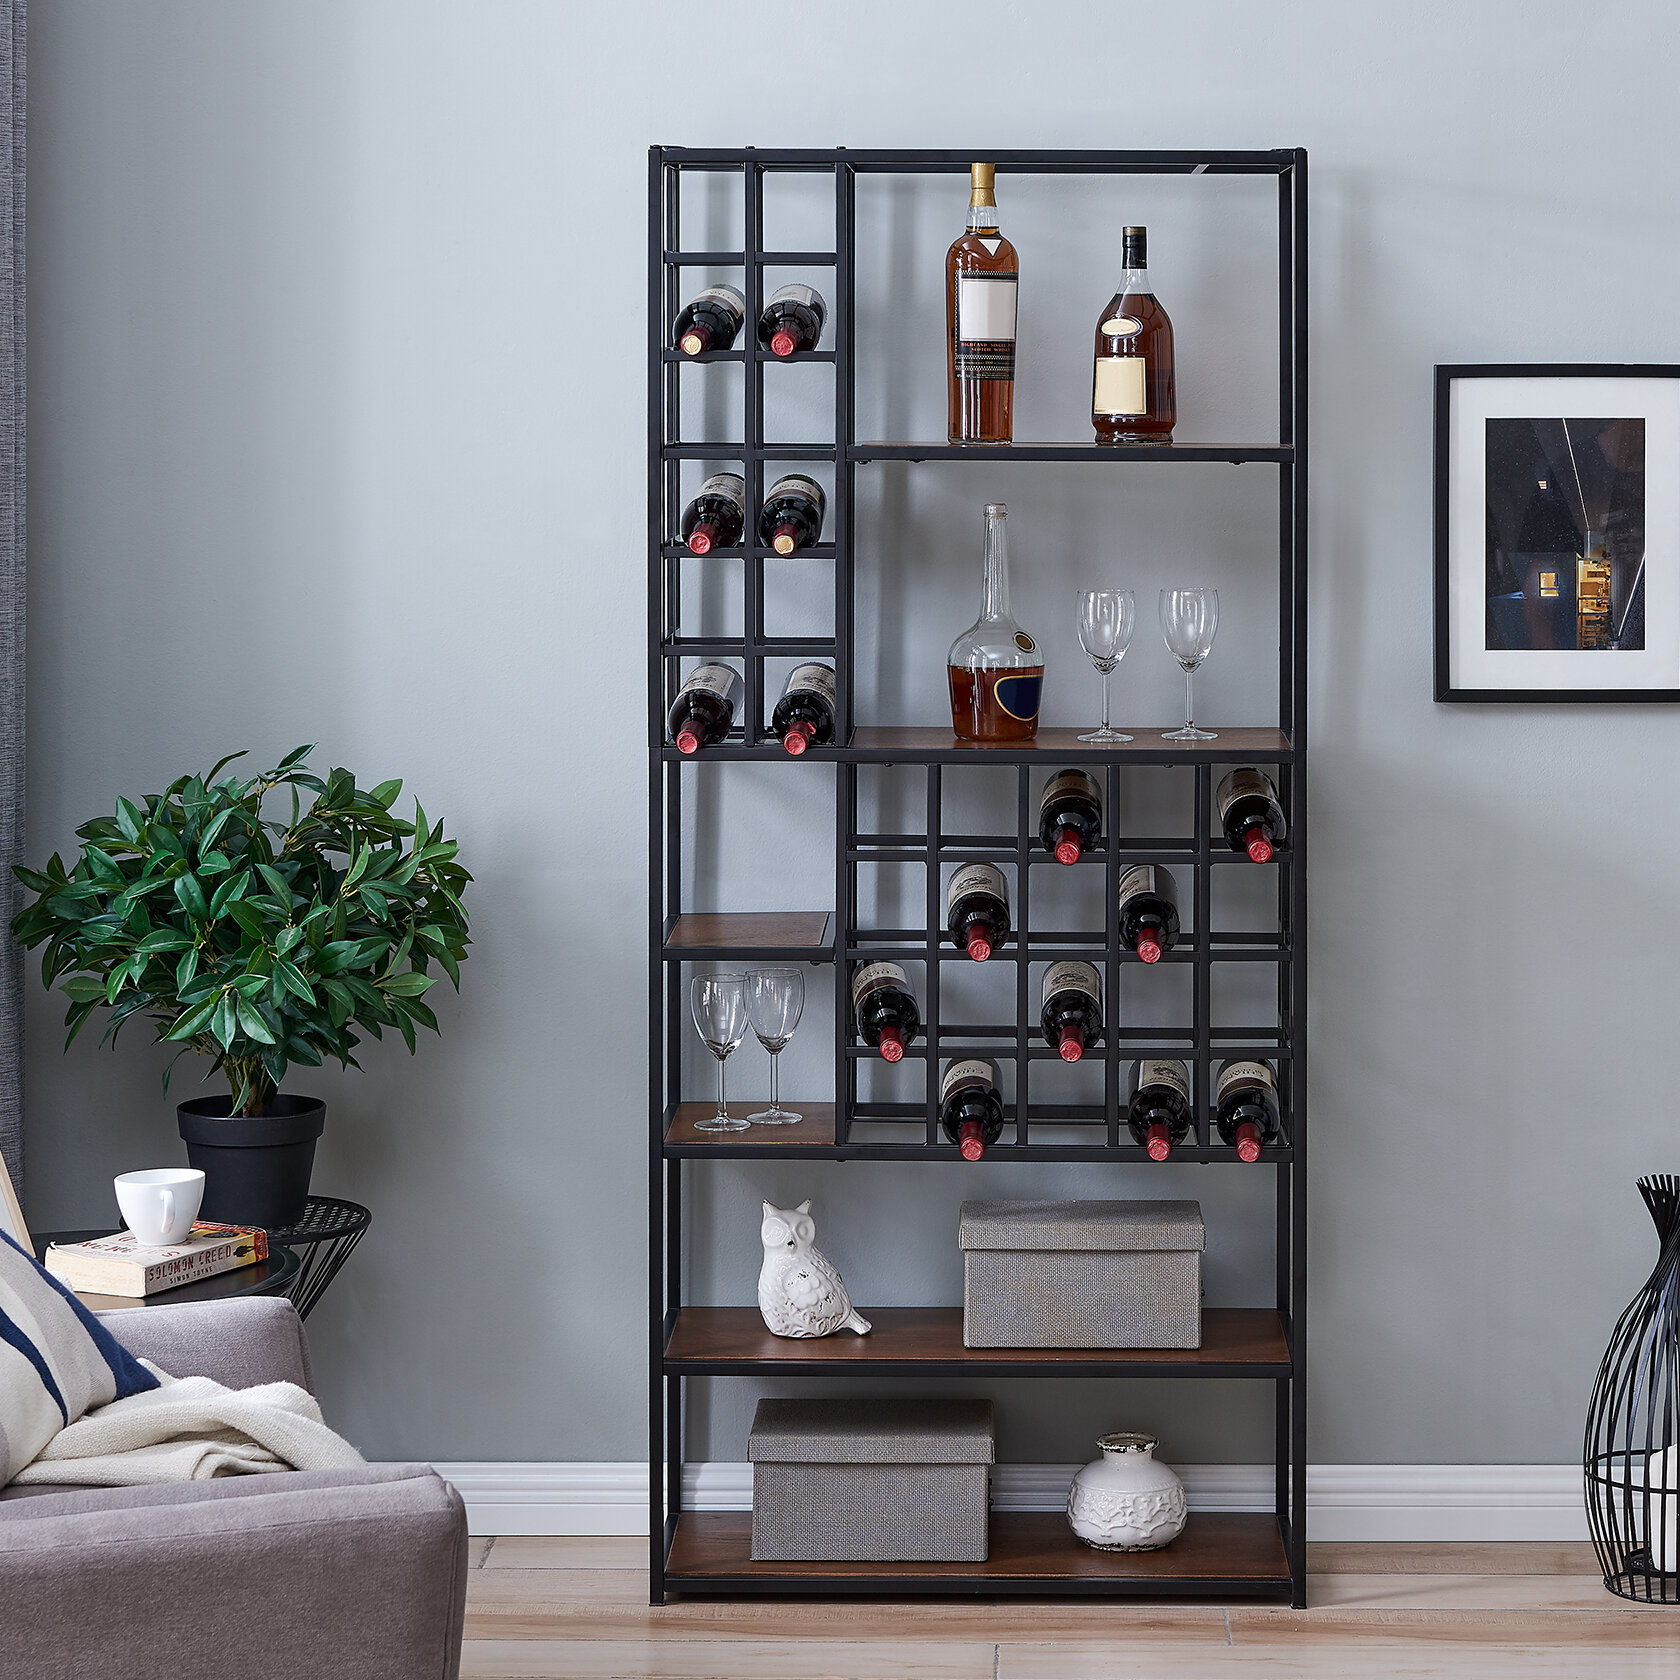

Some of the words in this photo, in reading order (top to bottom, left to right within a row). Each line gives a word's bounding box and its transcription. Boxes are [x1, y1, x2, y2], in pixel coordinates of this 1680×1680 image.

[149, 1255, 194, 1281] SOLOMON
[199, 1244, 232, 1265] CREED
[169, 1274, 190, 1284] SIMON
[193, 1266, 213, 1276] TOYNE
